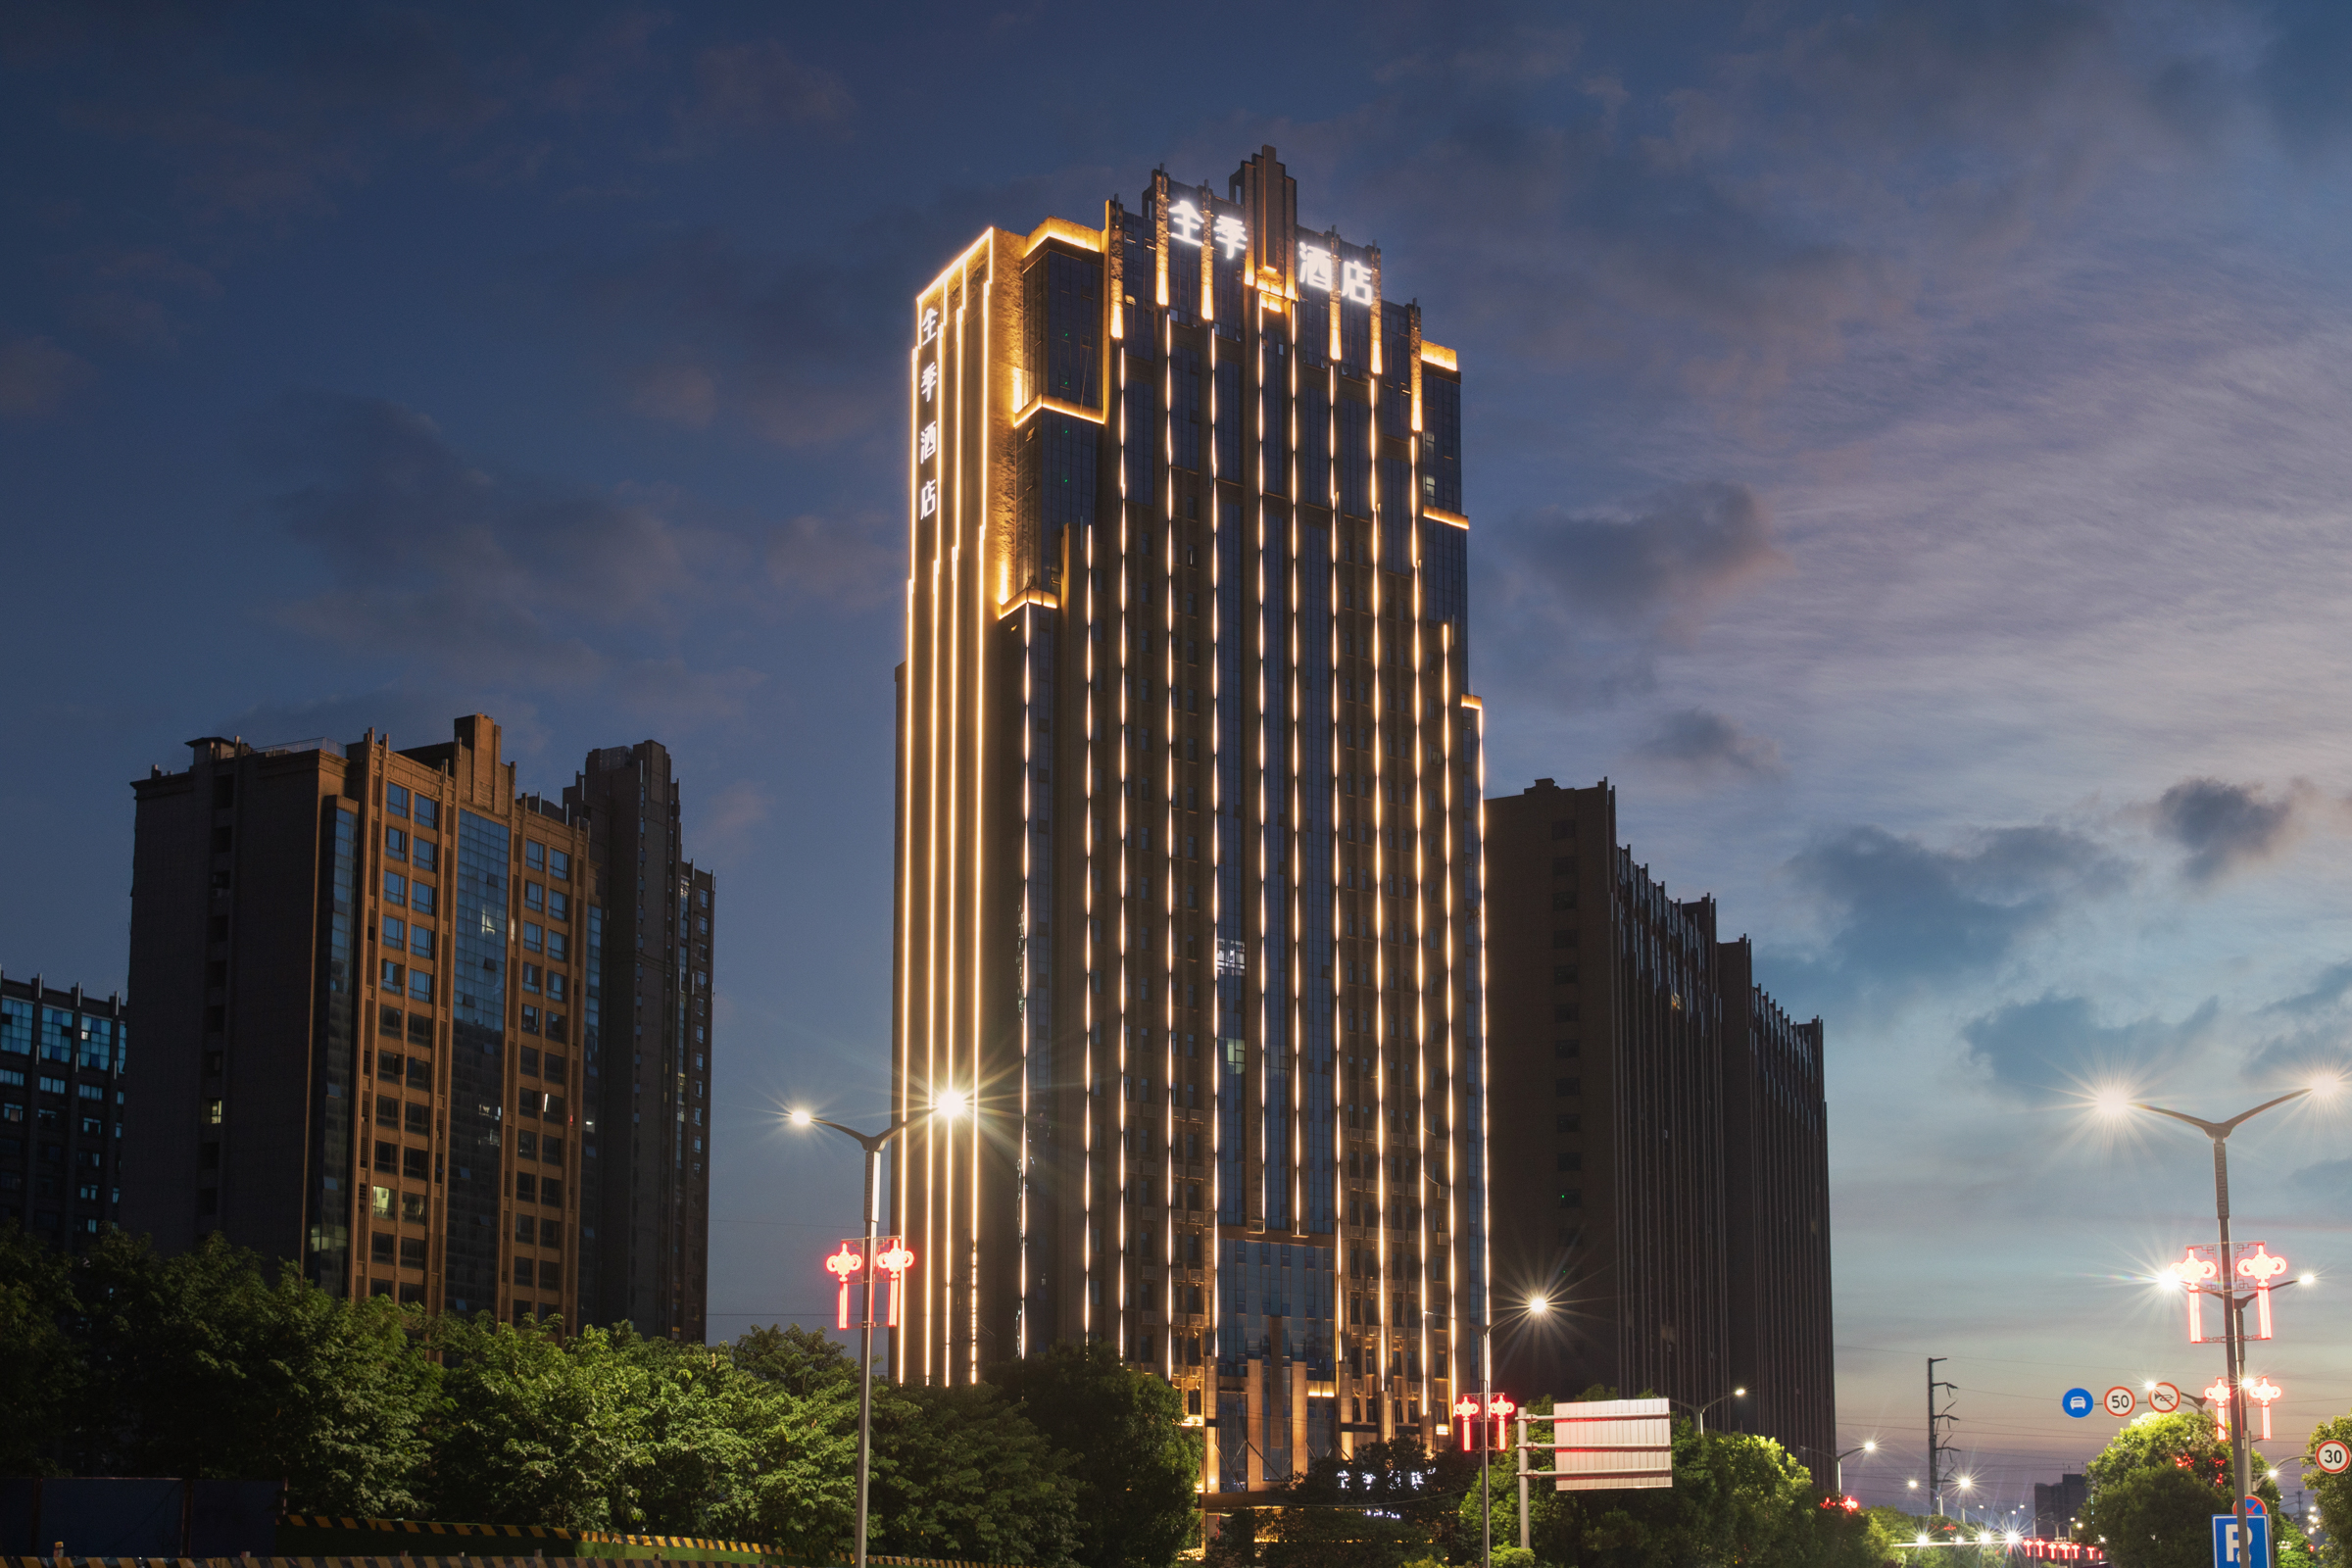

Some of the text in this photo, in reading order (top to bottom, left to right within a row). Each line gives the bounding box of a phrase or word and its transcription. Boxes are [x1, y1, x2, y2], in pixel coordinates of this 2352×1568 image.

[921, 308, 938, 520] 全季酒店
[2112, 1395, 2130, 1408] 50
[2325, 1449, 2342, 1463] 30
